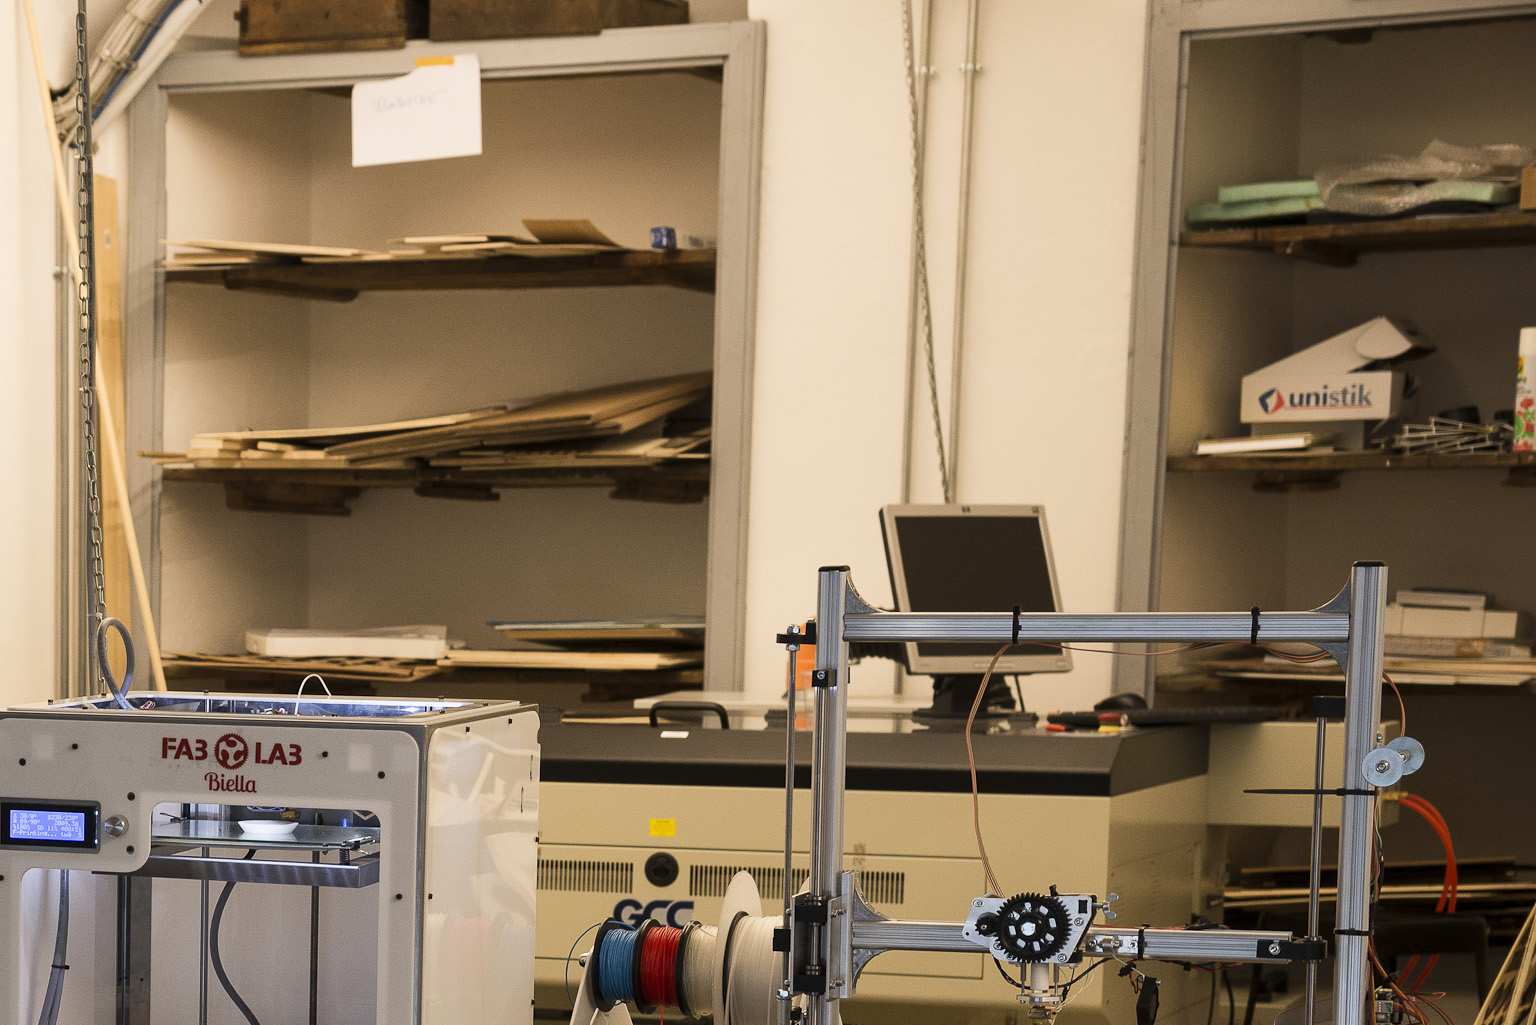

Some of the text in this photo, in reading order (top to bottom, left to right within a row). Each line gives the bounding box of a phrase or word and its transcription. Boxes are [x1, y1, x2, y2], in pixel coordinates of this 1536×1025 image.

[1289, 383, 1372, 407] unistik
[204, 772, 257, 793] Biella
[613, 898, 694, 930] GCC
